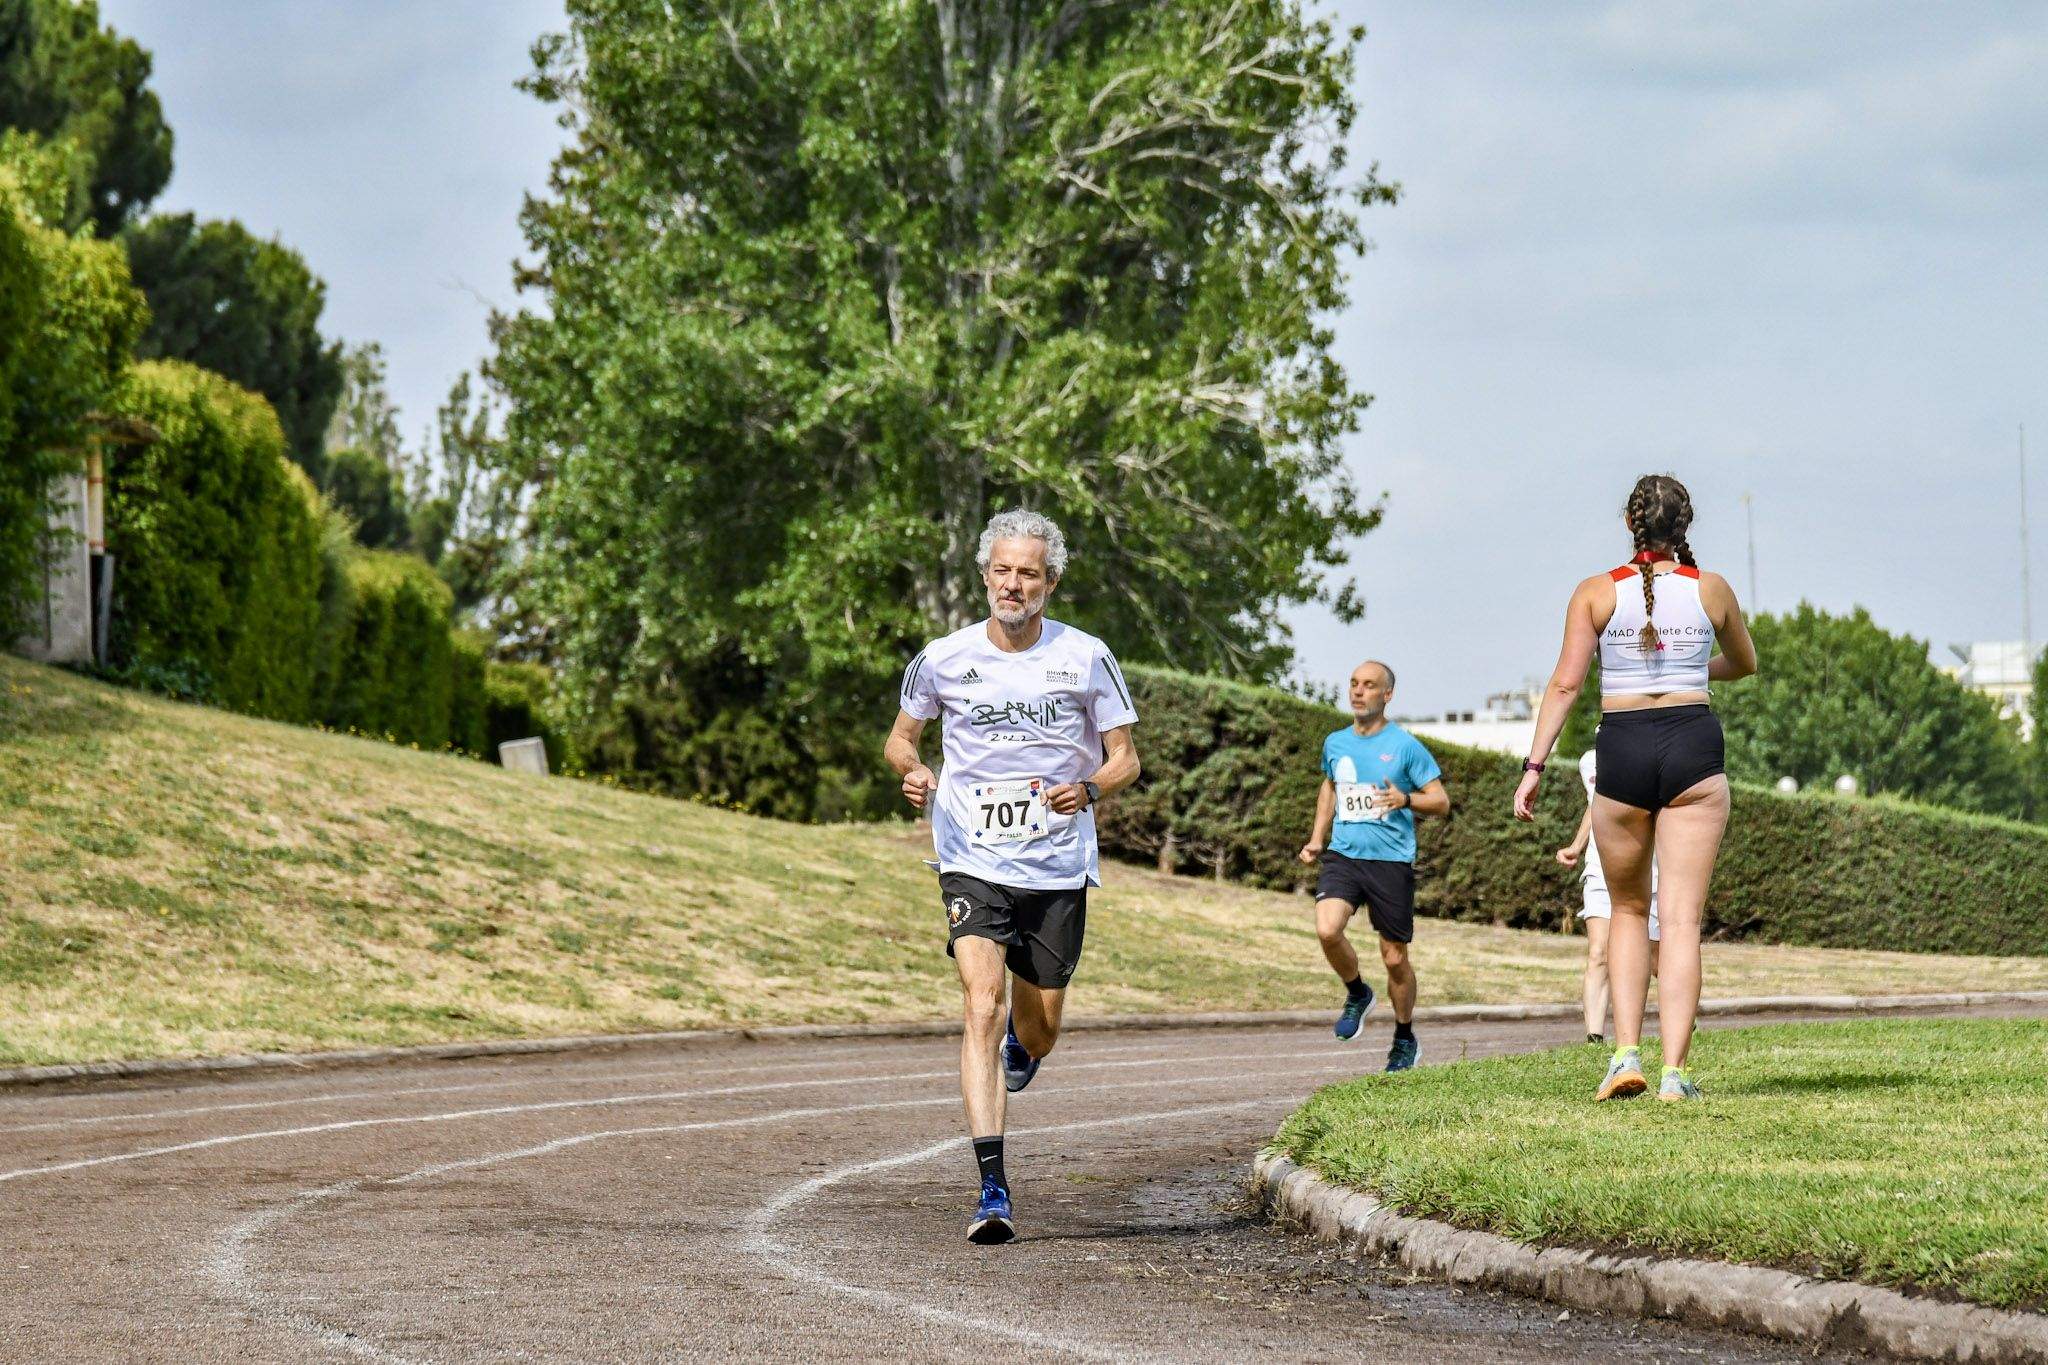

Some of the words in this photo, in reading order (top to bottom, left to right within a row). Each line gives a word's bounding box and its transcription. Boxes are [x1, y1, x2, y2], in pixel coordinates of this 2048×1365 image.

[1607, 628, 1635, 638] MAD
[1638, 626, 1682, 637] lete
[1685, 626, 1711, 636] Crew
[1346, 796, 1373, 811] 810
[980, 800, 1030, 829] 707
